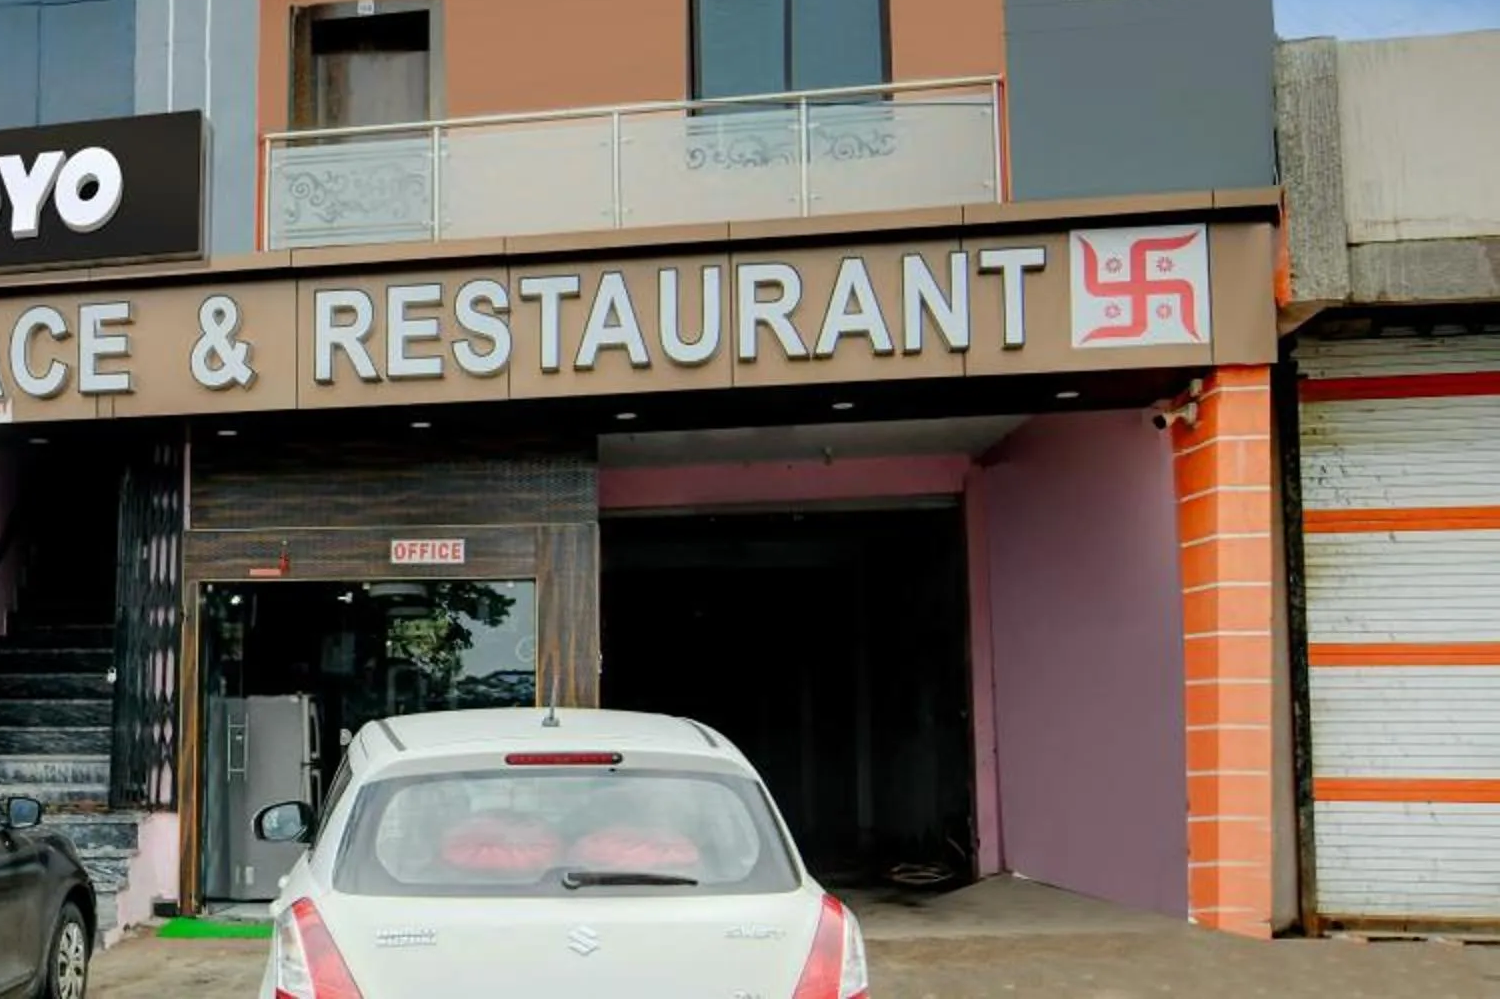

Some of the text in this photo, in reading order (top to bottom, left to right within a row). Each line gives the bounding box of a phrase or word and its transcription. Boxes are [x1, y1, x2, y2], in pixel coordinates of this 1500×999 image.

[189, 294, 258, 392] &
[313, 246, 1047, 386] RESTAURANT
[394, 542, 461, 561] OFFICE
